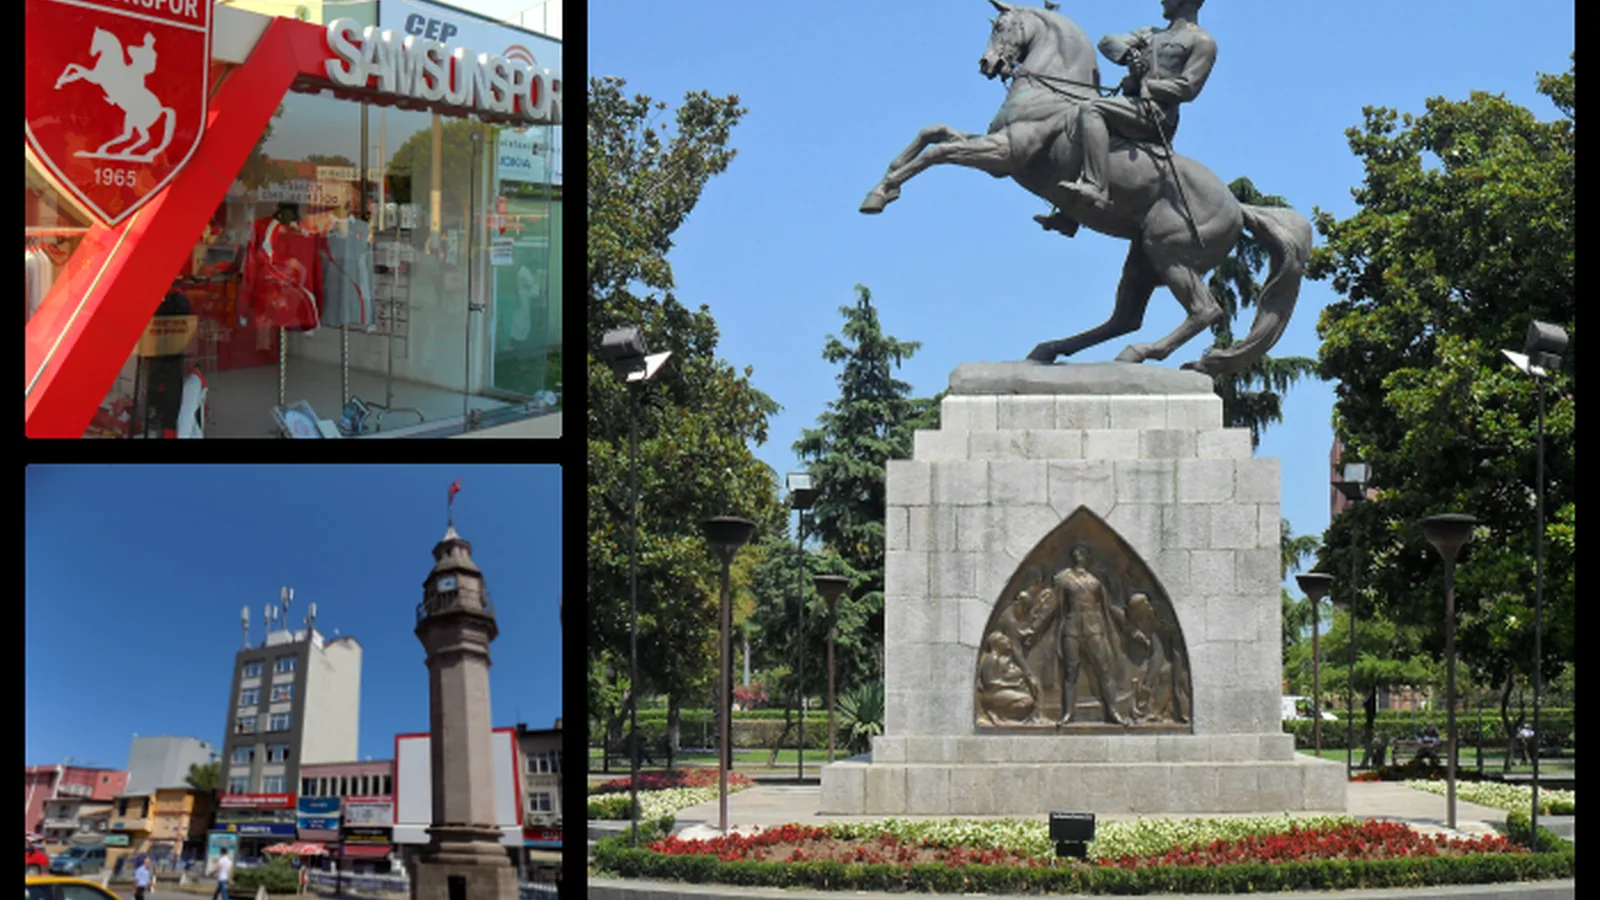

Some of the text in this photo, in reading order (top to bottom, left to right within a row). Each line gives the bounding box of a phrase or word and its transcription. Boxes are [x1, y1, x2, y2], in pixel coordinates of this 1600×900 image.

[404, 13, 458, 43] CEP
[325, 17, 562, 122] SAMSUNSPOR
[93, 168, 137, 187] 1965
